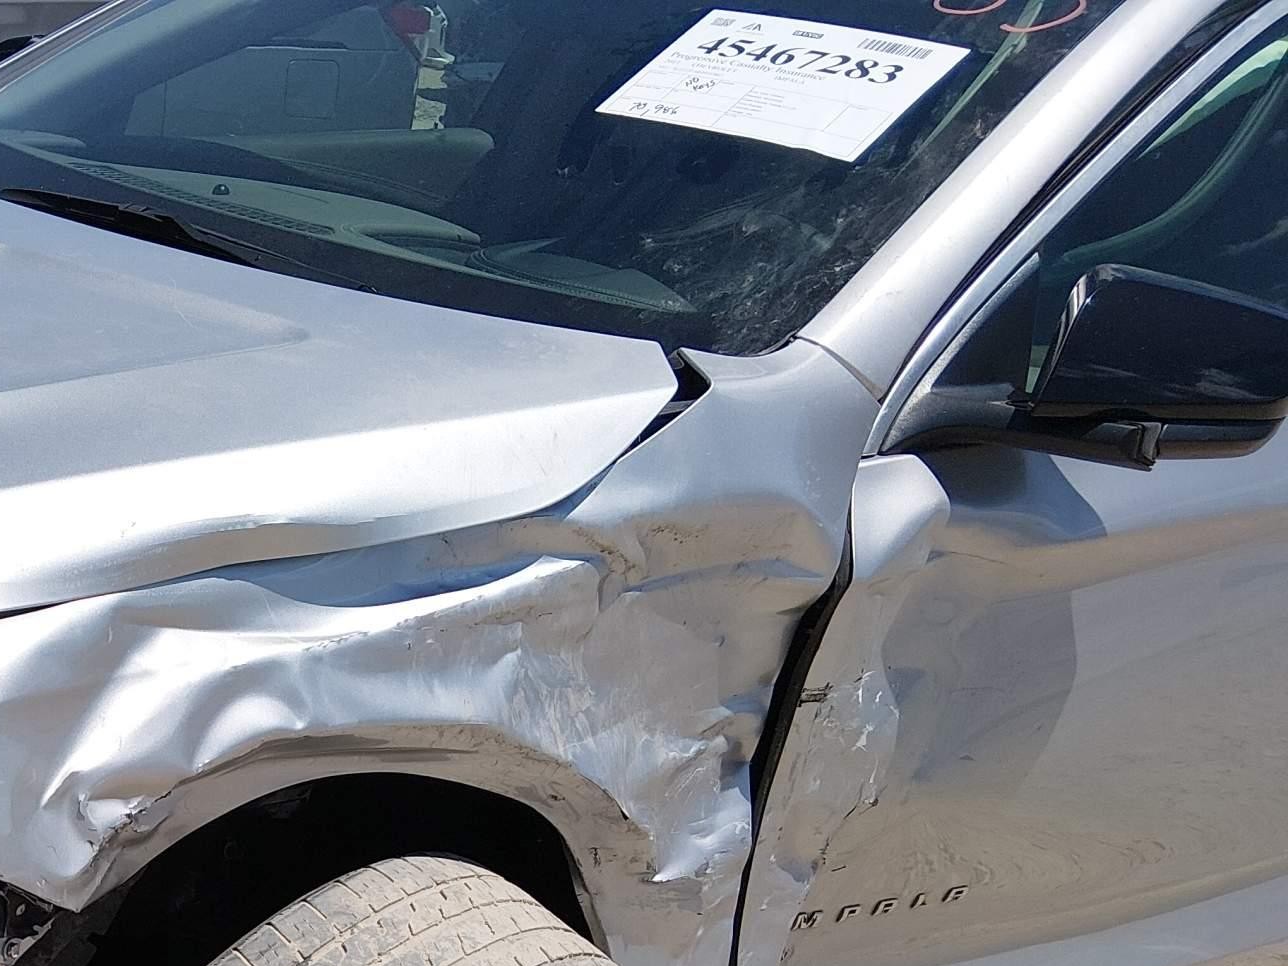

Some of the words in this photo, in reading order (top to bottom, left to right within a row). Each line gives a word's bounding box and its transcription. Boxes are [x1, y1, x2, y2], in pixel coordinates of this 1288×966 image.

[671, 51, 728, 65] Progressive
[775, 66, 825, 81] Insurance
[697, 36, 904, 84] 45467283
